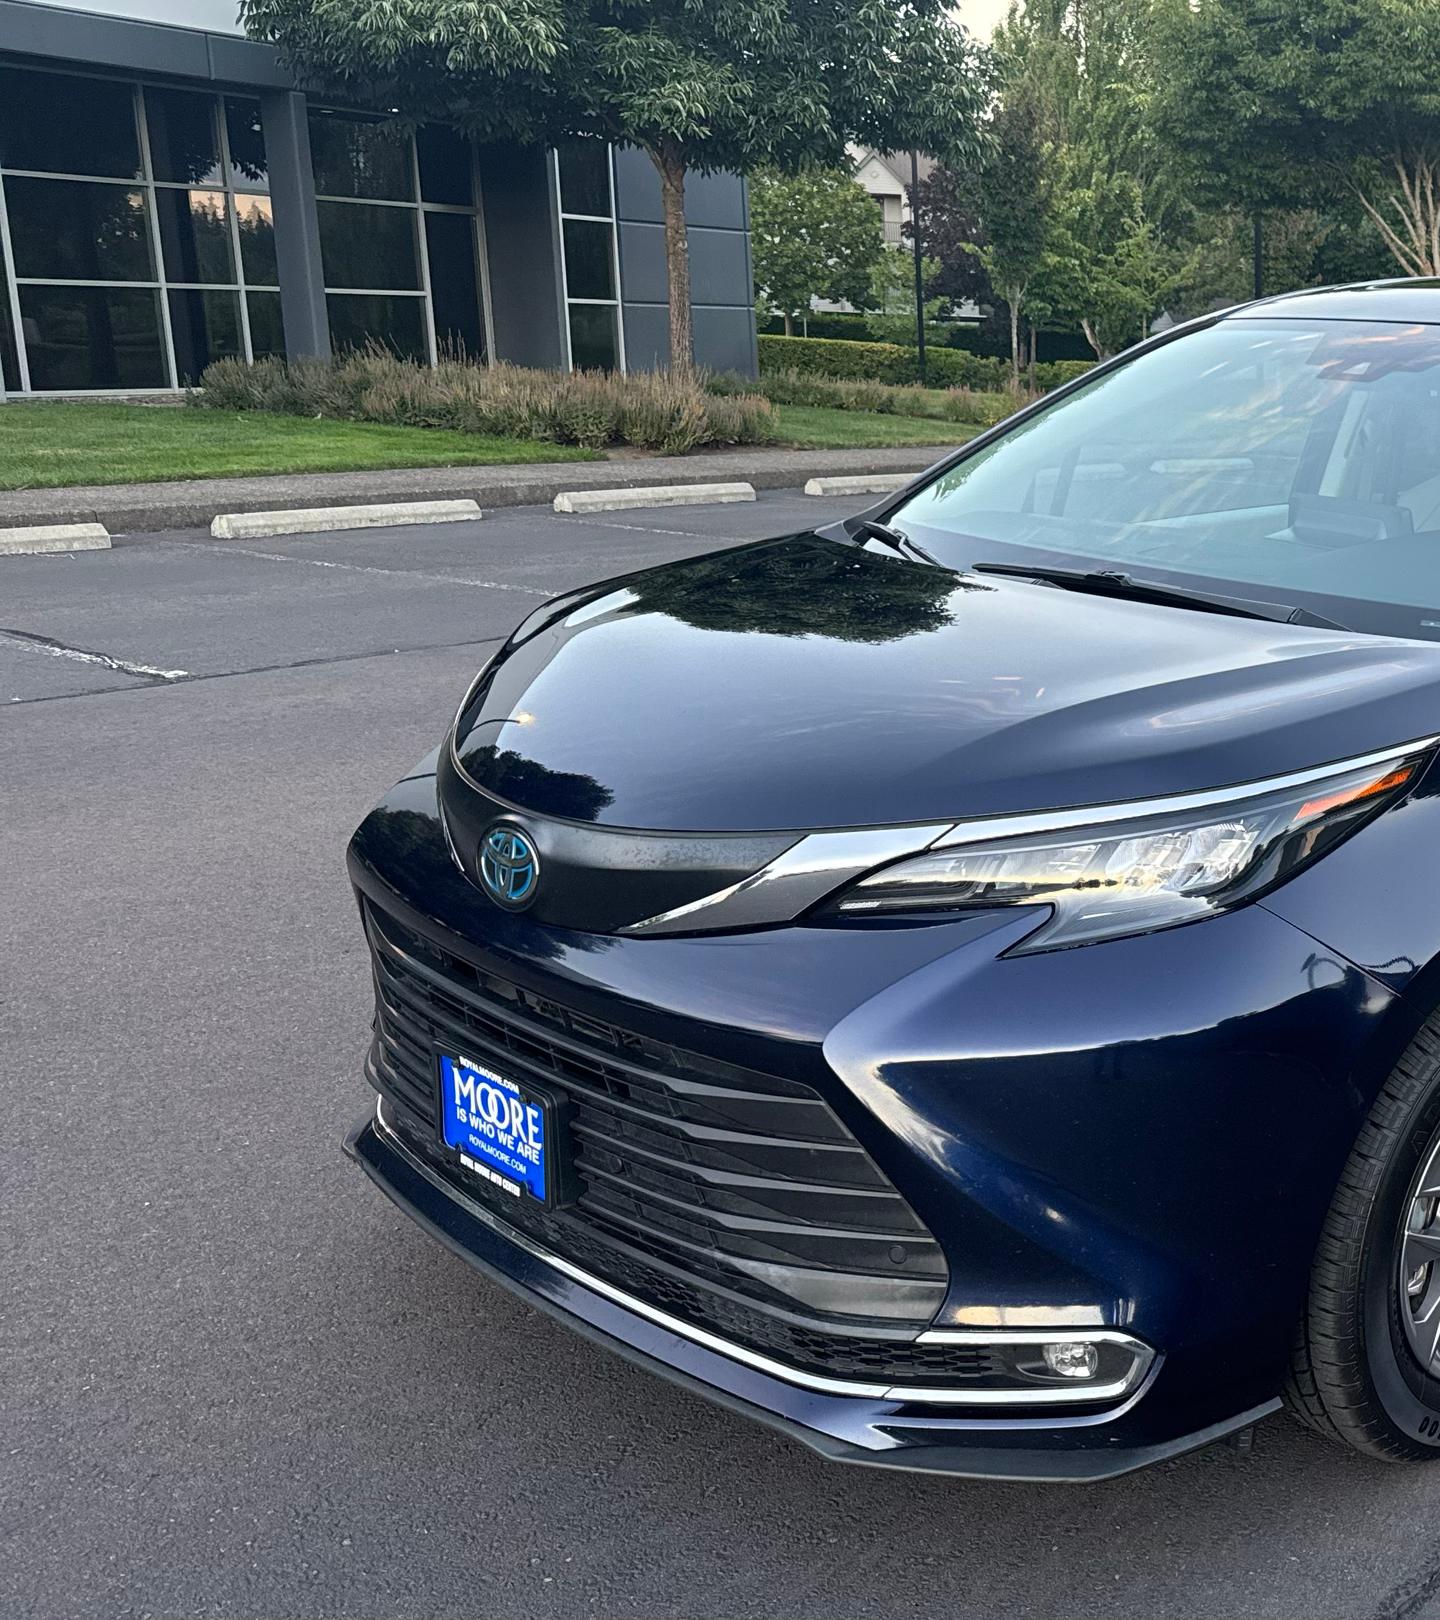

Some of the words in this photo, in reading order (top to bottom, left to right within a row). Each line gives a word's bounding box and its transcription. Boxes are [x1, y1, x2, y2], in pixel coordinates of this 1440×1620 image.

[459, 1056, 520, 1095] ROYALMOORE.COM
[452, 1066, 542, 1150] MOORE
[456, 1106, 468, 1123] IS
[469, 1113, 495, 1138] WHO
[498, 1129, 514, 1151] WE
[517, 1142, 540, 1165] ARE
[468, 1134, 527, 1175] ROYALMOORE.COM
